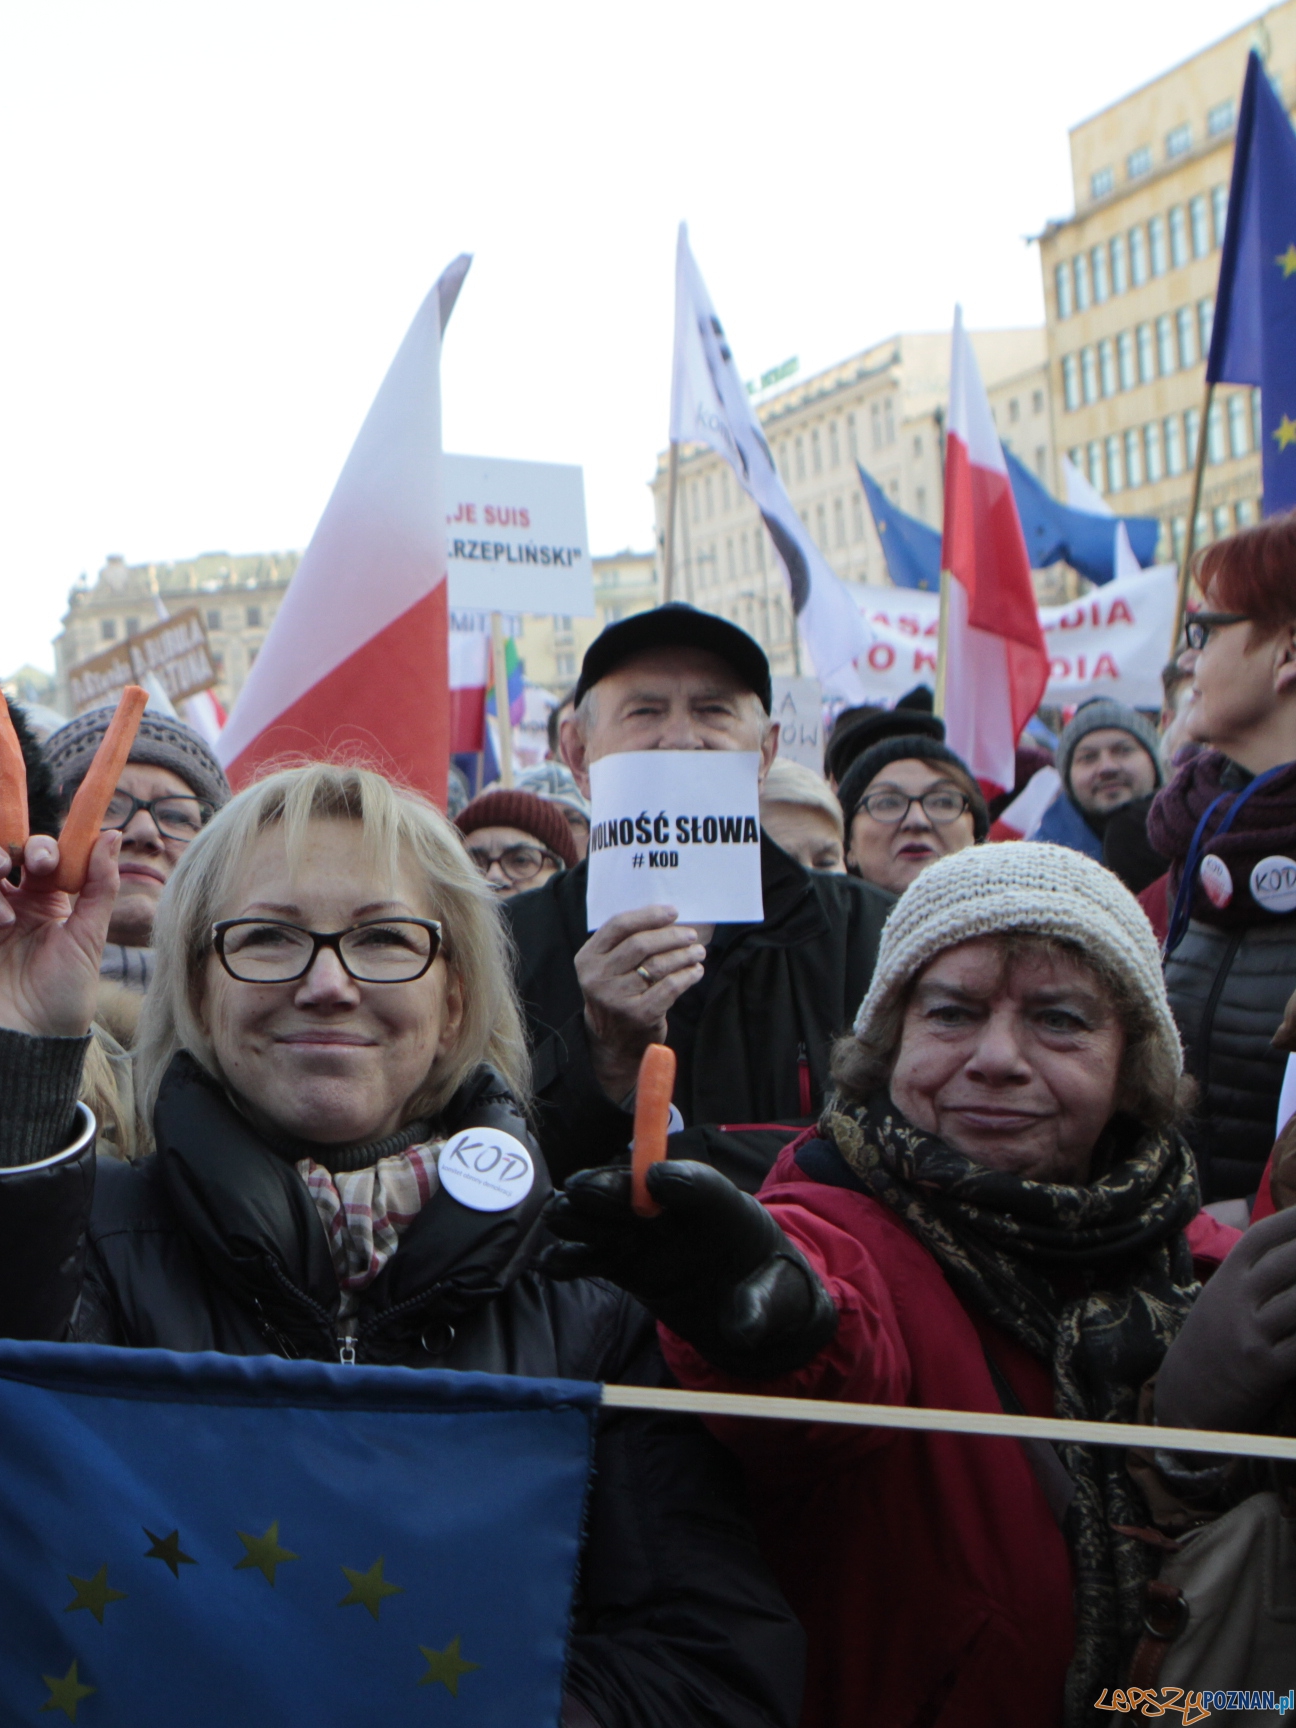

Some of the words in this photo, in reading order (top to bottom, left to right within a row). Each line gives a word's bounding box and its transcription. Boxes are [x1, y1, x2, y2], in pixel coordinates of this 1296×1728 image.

[484, 504, 531, 528] SUIS
[591, 810, 670, 853] WOLNOŚĆ
[675, 815, 759, 844] SŁOWA
[649, 850, 679, 868] KOD
[1255, 866, 1296, 892] KOD
[449, 1135, 529, 1182] KOD
[441, 1163, 463, 1177] komitet
[463, 1171, 482, 1186] obrony
[482, 1178, 513, 1198] demokracji
